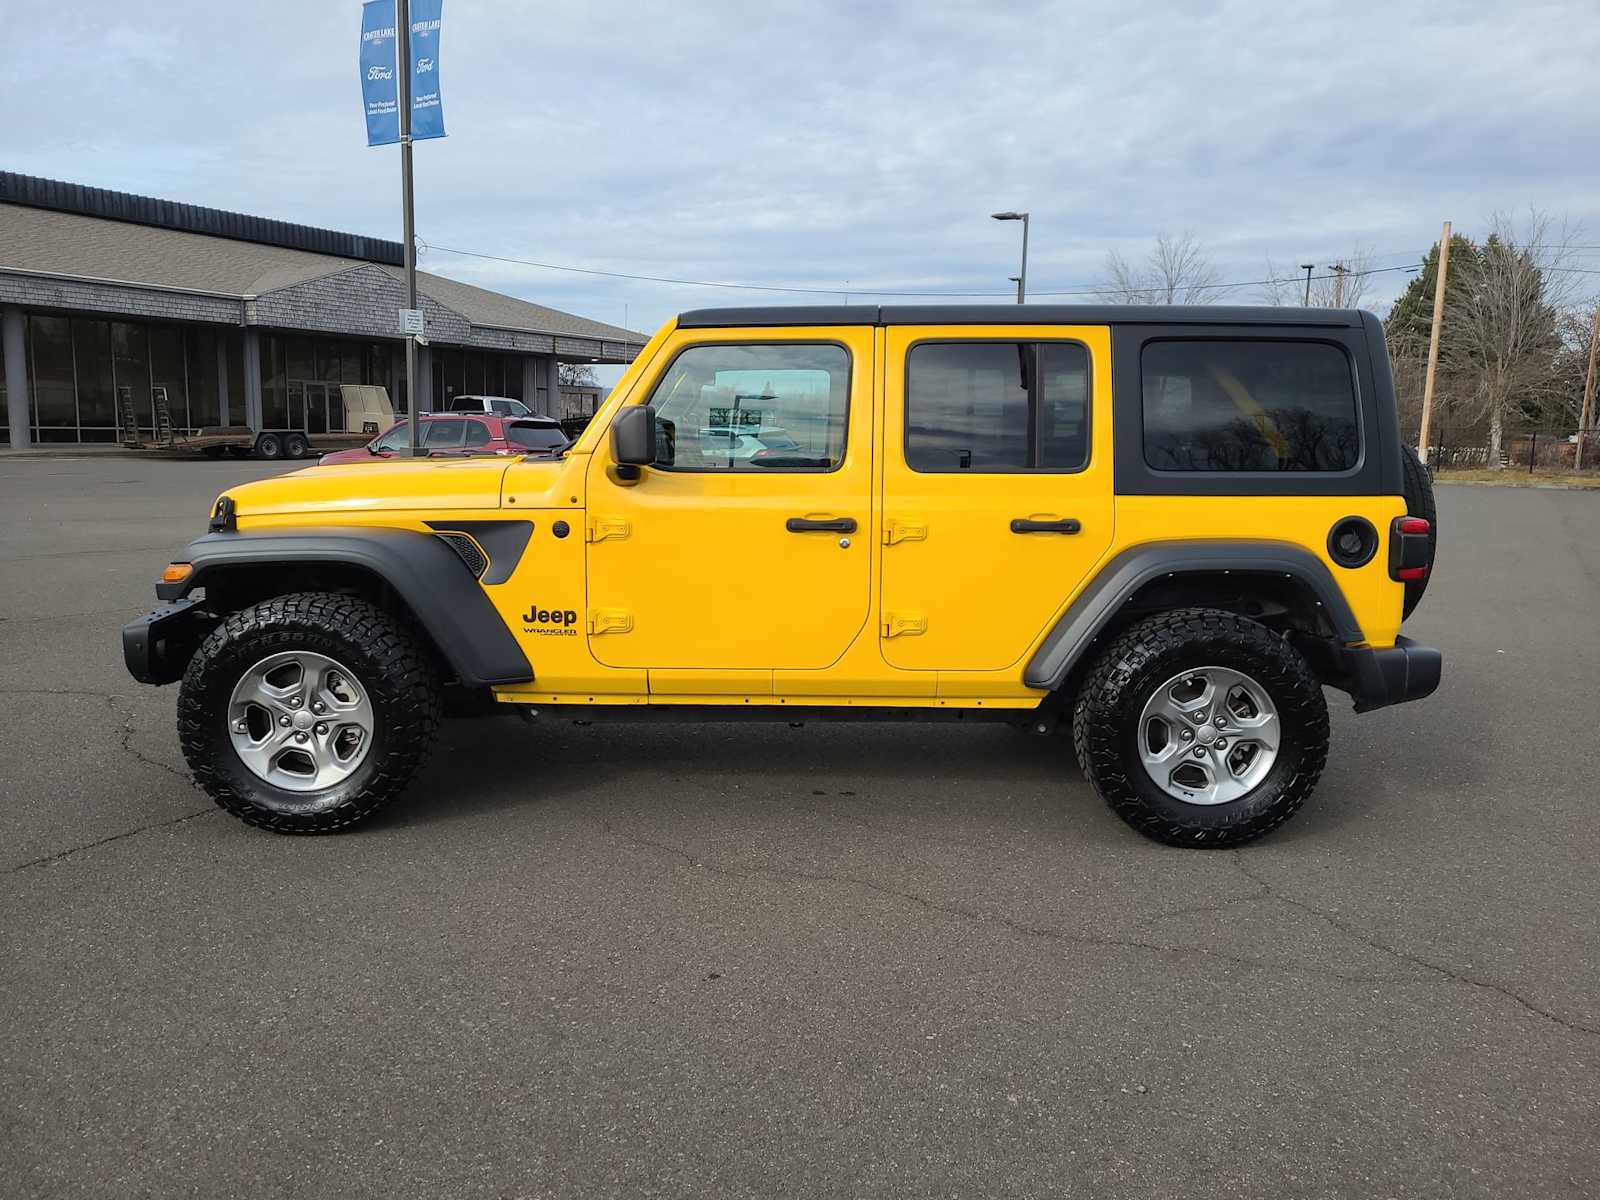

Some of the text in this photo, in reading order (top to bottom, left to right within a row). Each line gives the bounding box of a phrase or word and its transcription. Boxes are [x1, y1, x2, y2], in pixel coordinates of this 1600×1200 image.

[380, 27, 395, 39] LAKE
[367, 66, 392, 80] Ford
[416, 58, 434, 74] Ford
[522, 605, 577, 627] Jeep
